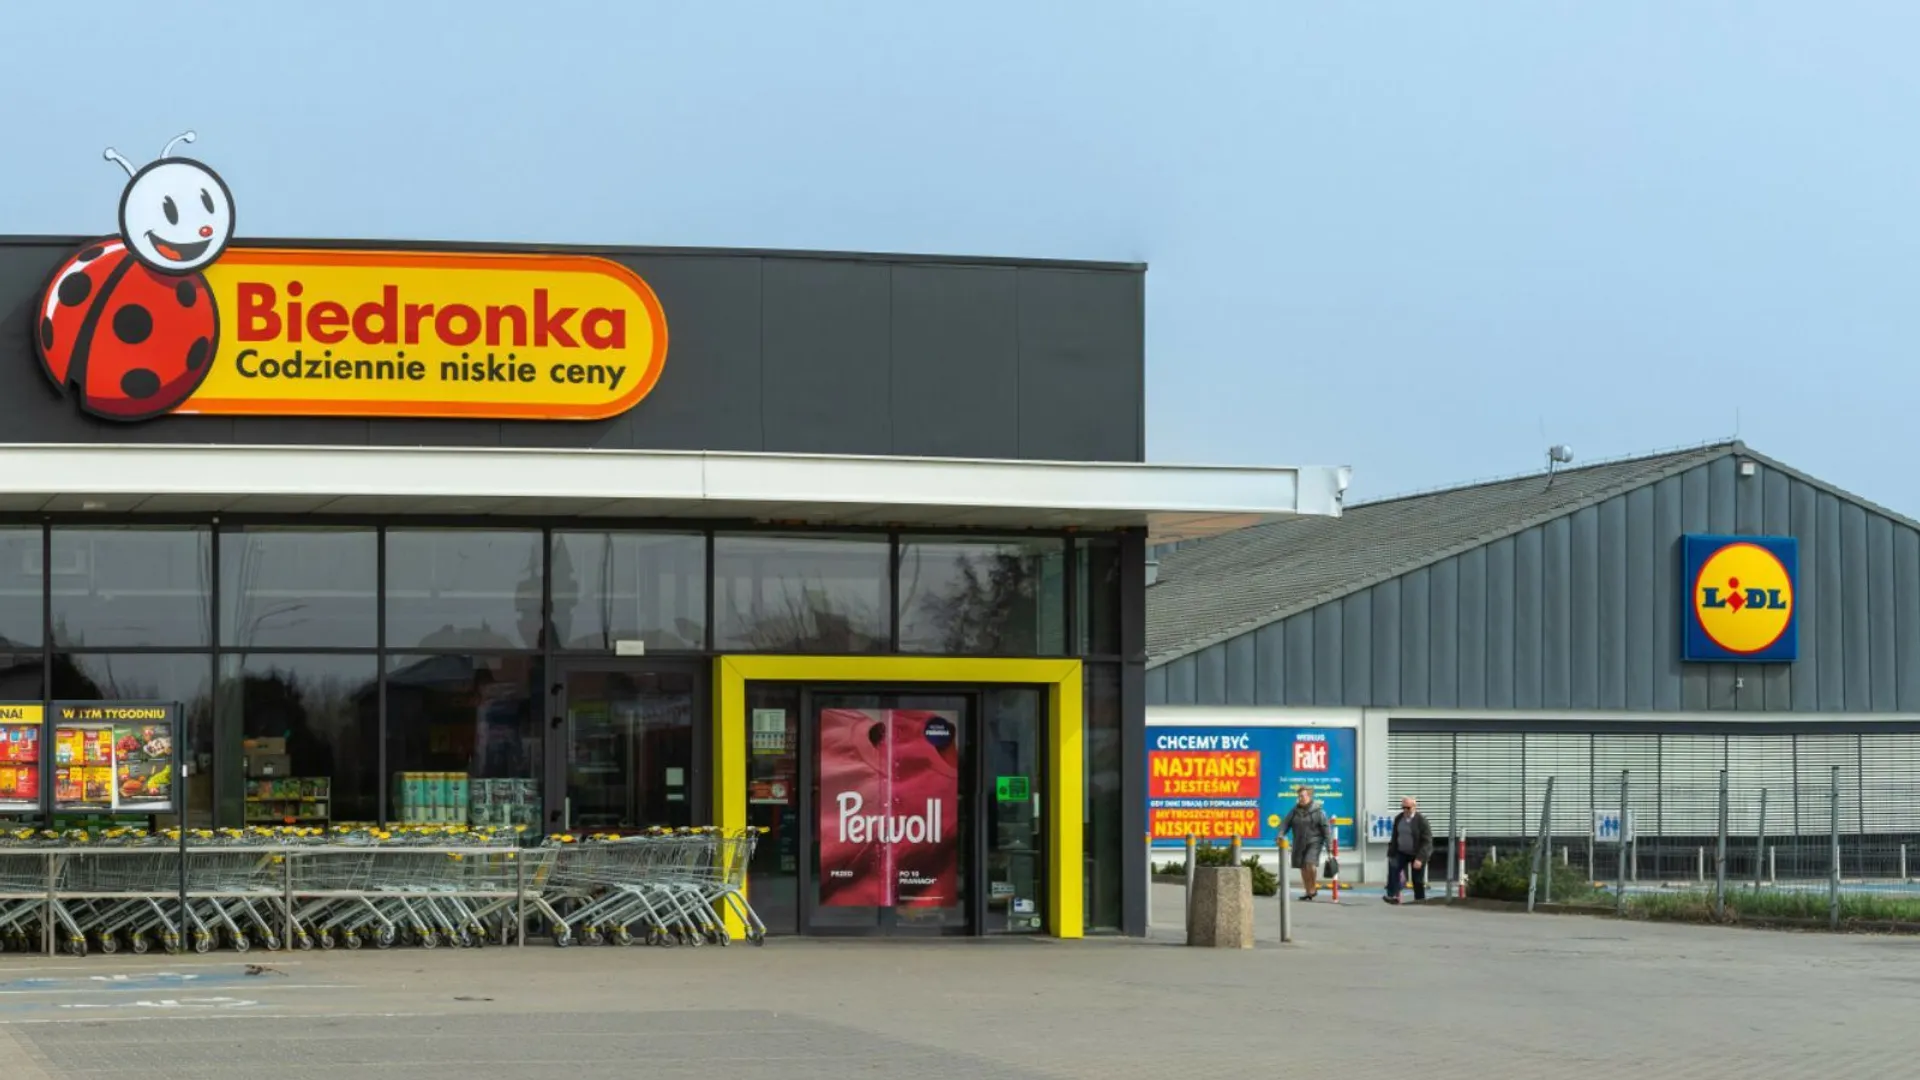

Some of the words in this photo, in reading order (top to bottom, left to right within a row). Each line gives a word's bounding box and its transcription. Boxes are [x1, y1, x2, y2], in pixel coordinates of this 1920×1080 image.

[236, 281, 627, 350] Biedronka
[235, 349, 425, 382] Codziennie
[440, 351, 537, 383] niskie
[549, 365, 627, 391] ceny
[1702, 576, 1787, 614] LIDL
[62, 708, 75, 719] W
[105, 708, 166, 719] TYGODNIU
[1156, 735, 1219, 749] CHCEMY
[1221, 732, 1250, 750] BYĆ
[1153, 754, 1257, 777] NAJTAŃSI
[1295, 743, 1326, 769] Fakt
[1164, 780, 1171, 793] I
[1173, 778, 1240, 793] JESTEŚMY
[836, 791, 942, 843] Perwoll
[1246, 810, 1254, 818] O
[1155, 821, 1211, 836] NISKIE
[1213, 821, 1256, 836] CENY
